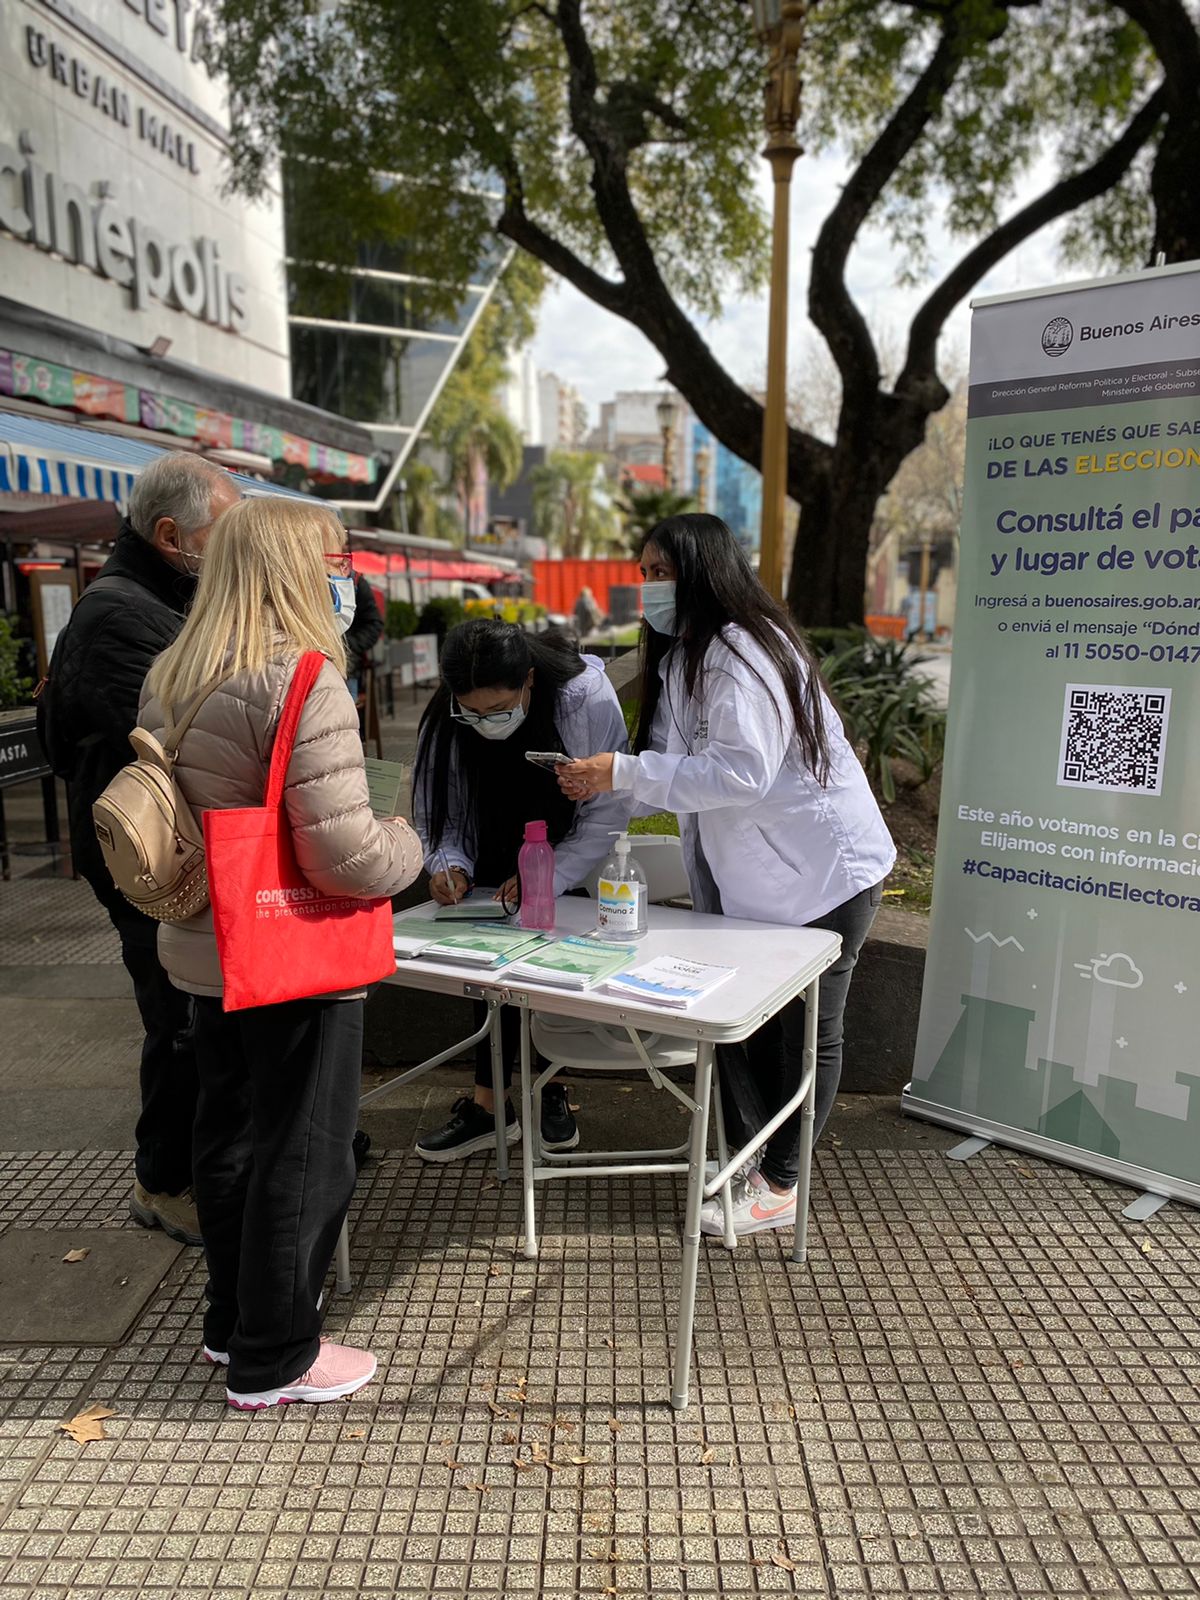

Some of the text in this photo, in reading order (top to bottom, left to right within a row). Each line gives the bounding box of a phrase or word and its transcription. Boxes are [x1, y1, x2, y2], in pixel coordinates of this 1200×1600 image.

[26, 25, 199, 175] URBAN MALL
[0, 129, 250, 332] cinépolis
[1080, 314, 1200, 341] Buenos Aires
[992, 387, 1026, 398] Dirección
[1028, 384, 1057, 395] General
[1058, 381, 1092, 392] Reforma
[1093, 376, 1123, 388] Política
[1124, 377, 1130, 385] y
[1131, 371, 1168, 383] Electoral
[1101, 381, 1196, 397] Ministerio de Gobierno
[988, 436, 1015, 451] ¡LO
[1020, 433, 1056, 449] QUE
[1061, 425, 1117, 445] TENÉS
[1122, 423, 1161, 440] QUE
[987, 461, 1017, 479] DE
[1024, 457, 1068, 477] LAS
[996, 503, 1124, 534] Consultá
[1132, 502, 1161, 529] el
[990, 544, 1200, 576] y lugar de vot
[975, 594, 1028, 609] Ingresá
[1032, 597, 1040, 607] a
[998, 622, 1007, 632] o
[1012, 619, 1051, 633] enviá
[1056, 620, 1069, 633] el
[1073, 620, 1138, 637] mensaje
[1046, 643, 1200, 663] al 11 5050-0147
[958, 804, 995, 823] Este
[999, 810, 1034, 828] año
[1038, 817, 1119, 840] votamos
[1126, 829, 1152, 844] en
[1158, 829, 1176, 847] la
[980, 831, 1056, 856] Elijamos
[1061, 845, 1094, 861] con
[962, 858, 1200, 912] #CapacitaciónElectora
[256, 909, 270, 919] the
[275, 903, 337, 919] presentation
[600, 903, 627, 915] Comuna
